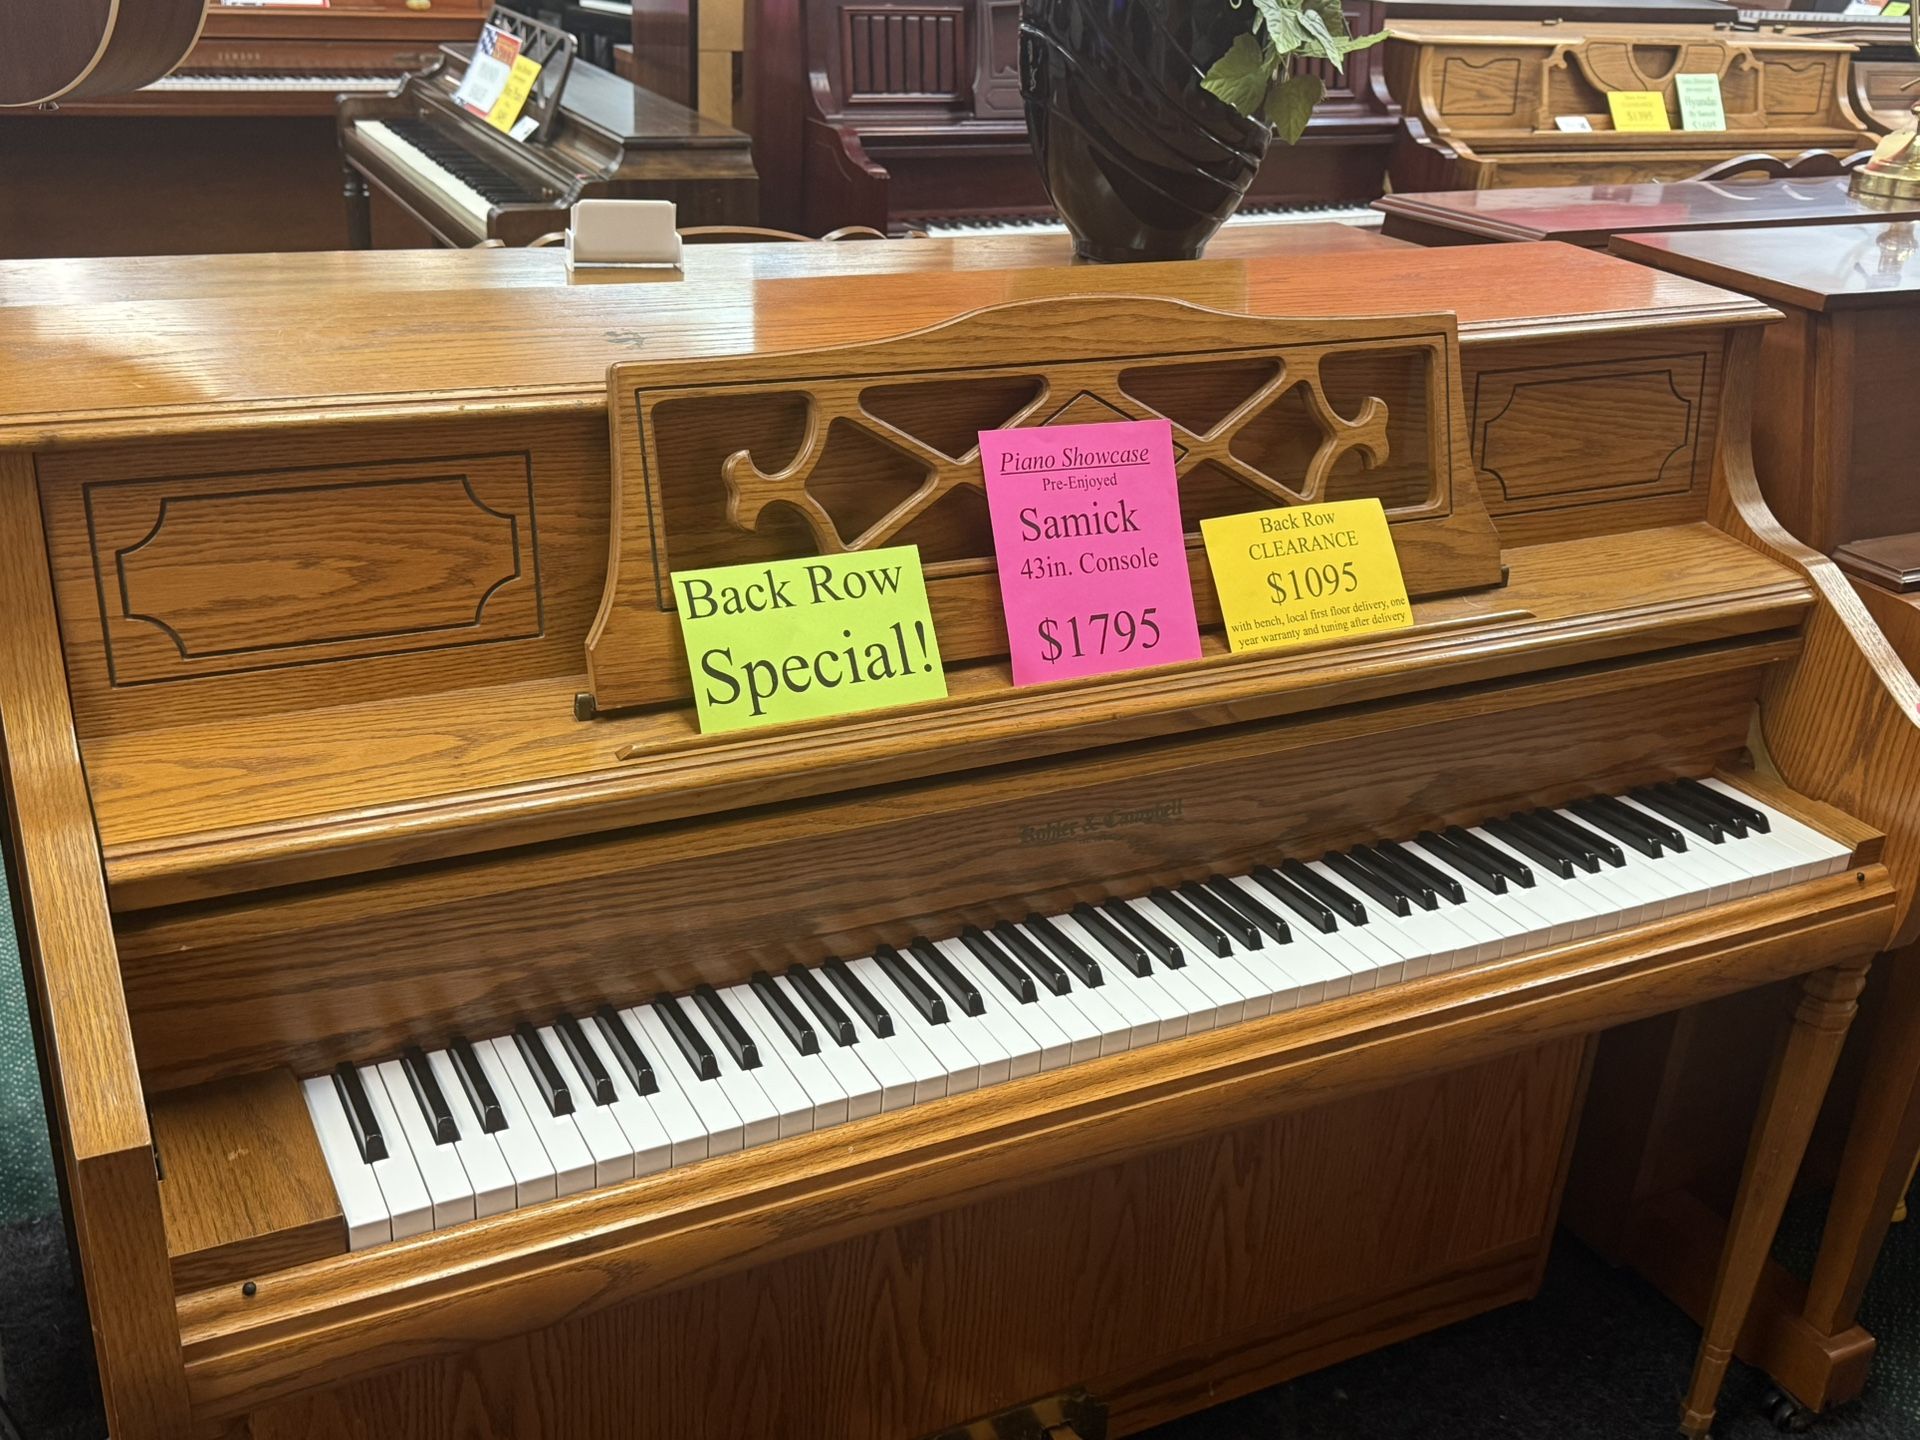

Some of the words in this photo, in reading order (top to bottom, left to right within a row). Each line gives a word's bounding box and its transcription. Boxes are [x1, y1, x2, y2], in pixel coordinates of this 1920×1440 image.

[999, 452, 1055, 473] Piano
[1062, 447, 1149, 468] Showcase
[1042, 473, 1118, 492] Pre-Enjoyed
[1019, 499, 1141, 542] Samick
[1259, 513, 1300, 534] Back
[1302, 511, 1336, 528] Row
[1020, 555, 1073, 580] 43in.
[1079, 547, 1159, 574] Console
[1248, 530, 1359, 561] CLEARANCE
[679, 569, 796, 620] Back
[803, 564, 902, 604] Row
[1266, 561, 1358, 606] $1095
[1231, 619, 1252, 632] with
[1254, 615, 1285, 629] bench,
[1286, 611, 1308, 624] local
[1310, 609, 1328, 620] first
[1330, 605, 1351, 617] floor
[1352, 600, 1390, 613] delivery,
[1390, 597, 1406, 607] one
[1238, 636, 1259, 649] year
[1261, 629, 1300, 643] warranty
[1303, 624, 1319, 636] and
[1320, 620, 1349, 632] tuning
[1350, 617, 1370, 629] after
[1371, 611, 1405, 624] delivery
[1038, 607, 1160, 664] $1795
[701, 620, 932, 717] Special!
